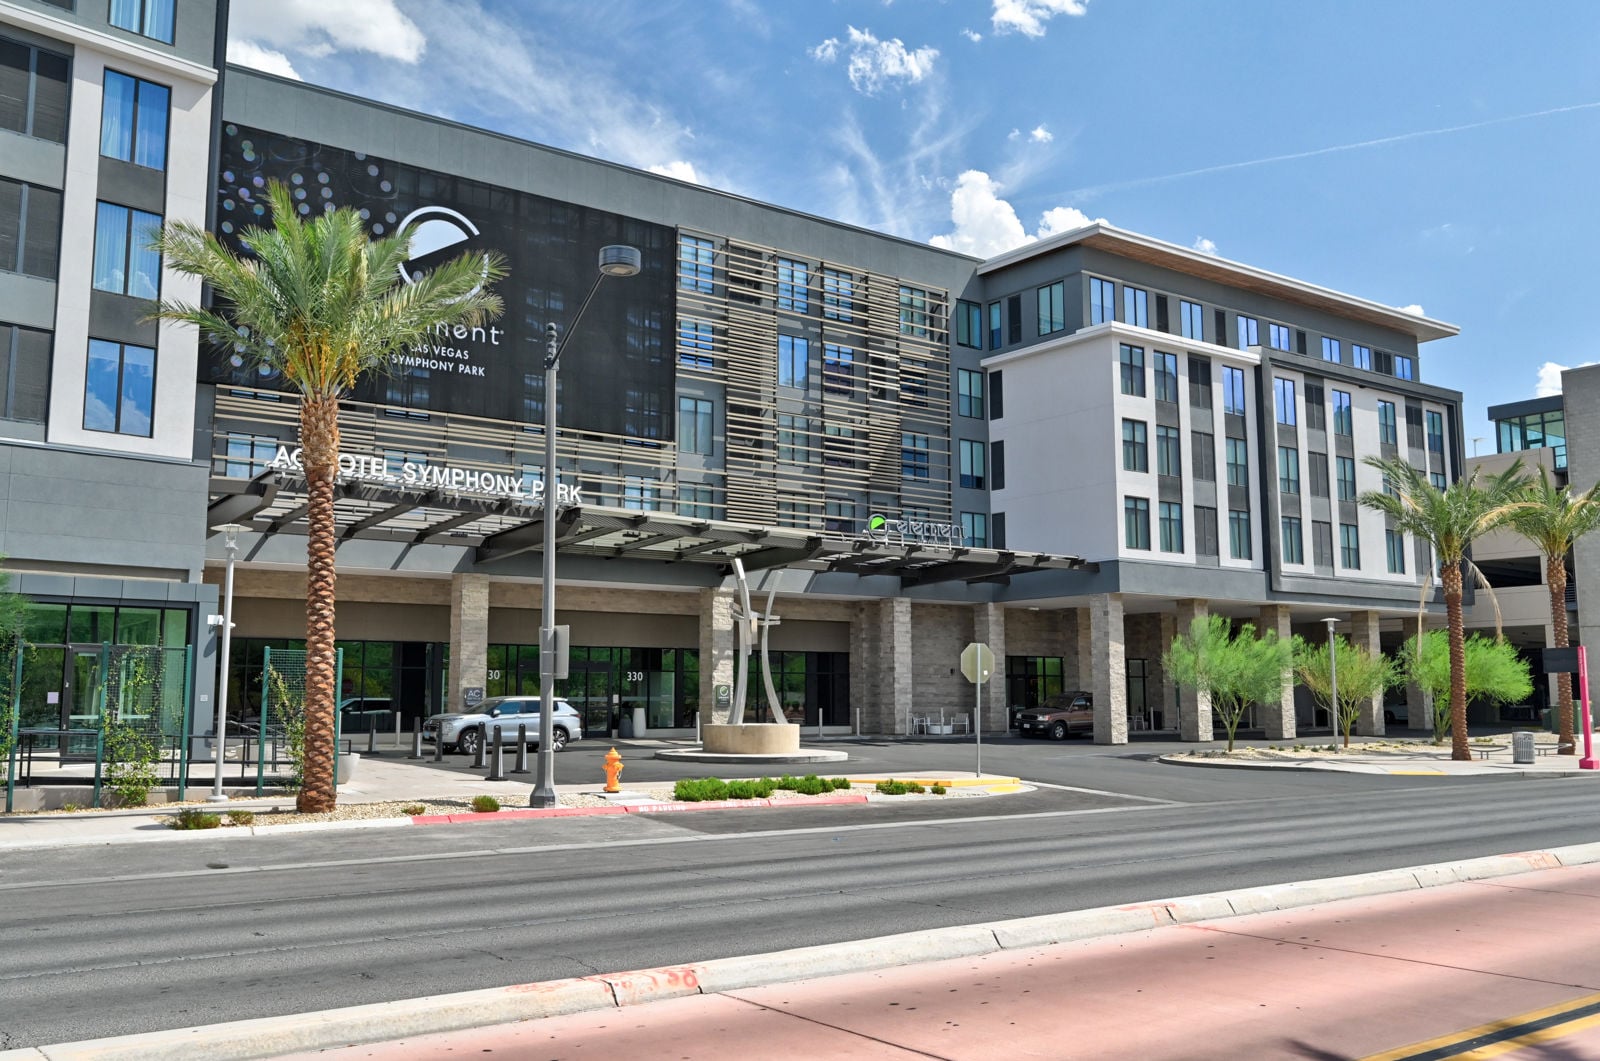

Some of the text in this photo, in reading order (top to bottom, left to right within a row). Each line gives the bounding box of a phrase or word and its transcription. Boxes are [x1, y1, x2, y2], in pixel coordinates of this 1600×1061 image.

[433, 344, 469, 360] VEGAS
[391, 354, 485, 377] SYMPHONY PARK
[338, 453, 394, 479] OTEL
[403, 462, 523, 496] SYMPHONY
[532, 480, 582, 503] PRK
[896, 516, 968, 540] element
[487, 669, 500, 680] 30
[626, 671, 644, 681] 330
[467, 689, 481, 698] AC
